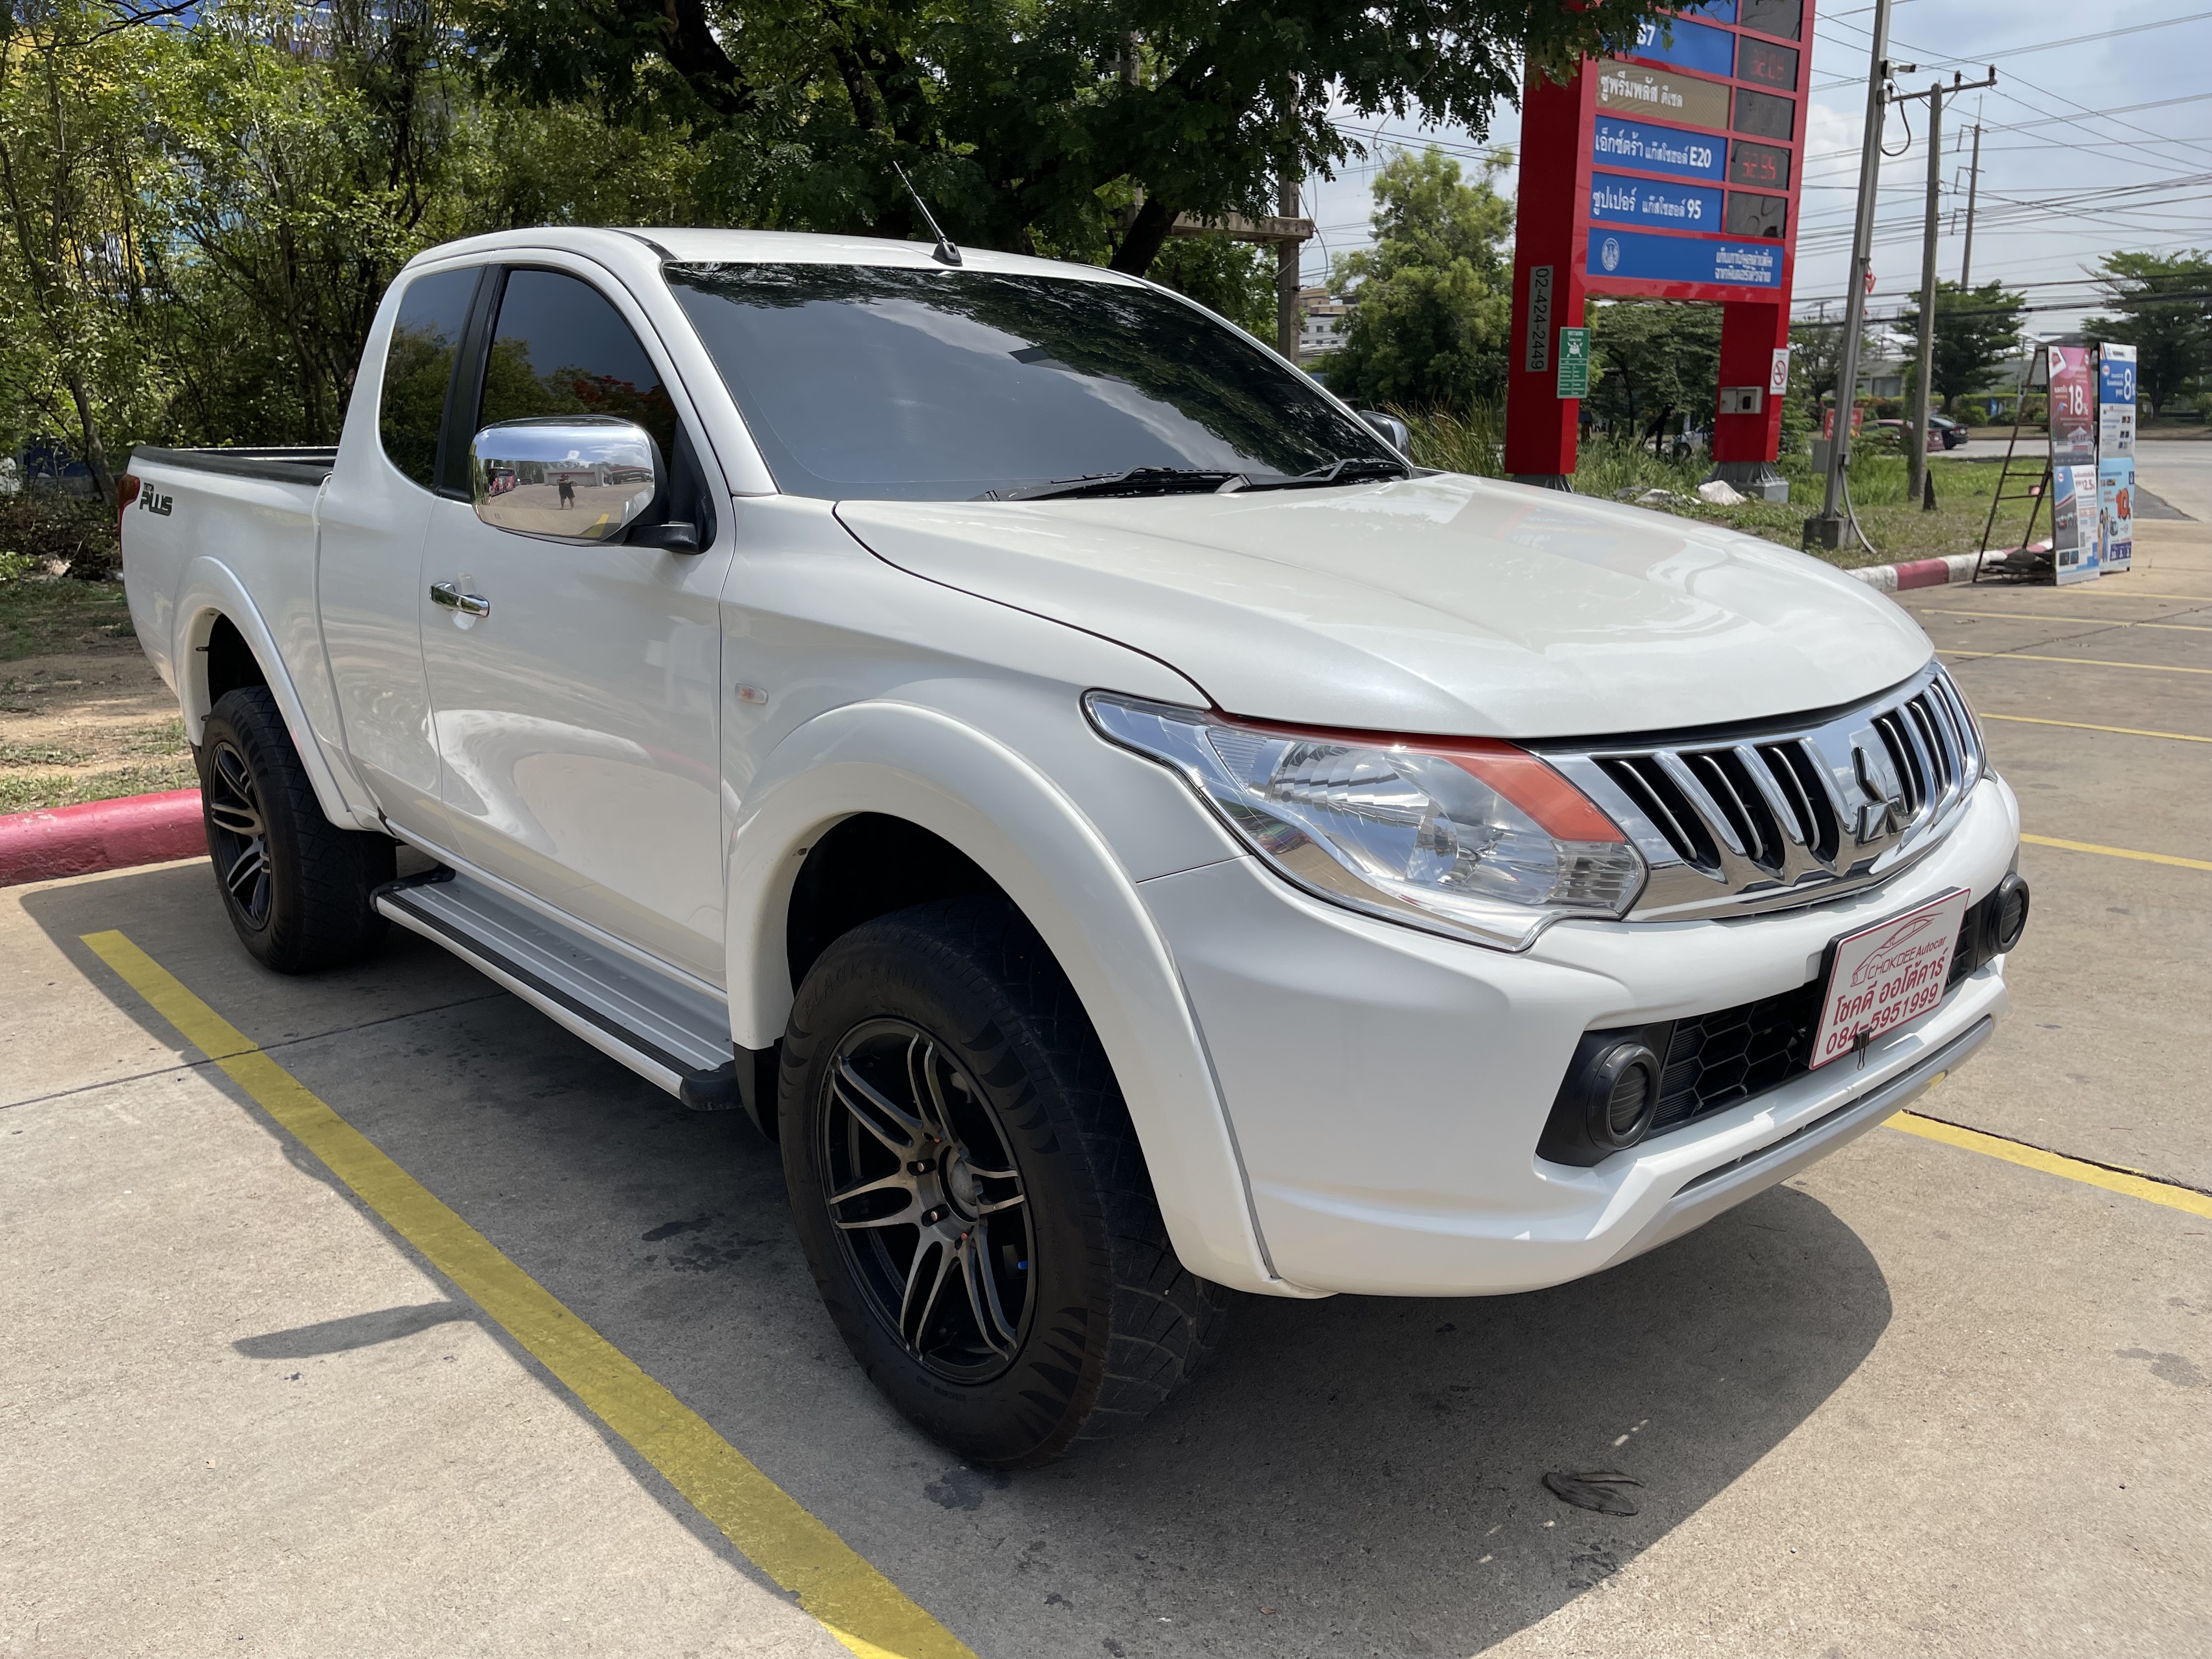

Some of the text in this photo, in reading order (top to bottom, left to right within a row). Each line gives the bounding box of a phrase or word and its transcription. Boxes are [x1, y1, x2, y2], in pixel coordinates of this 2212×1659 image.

[1689, 146, 1712, 168] E20
[1687, 199, 1702, 219] 95
[1531, 268, 1549, 370] 02-424-2449
[1833, 947, 1949, 1026] โชคดี ออโต้คาร์
[1867, 936, 1947, 980] CHOKDEE Autocar
[1826, 983, 1938, 1055] 084-5951999
